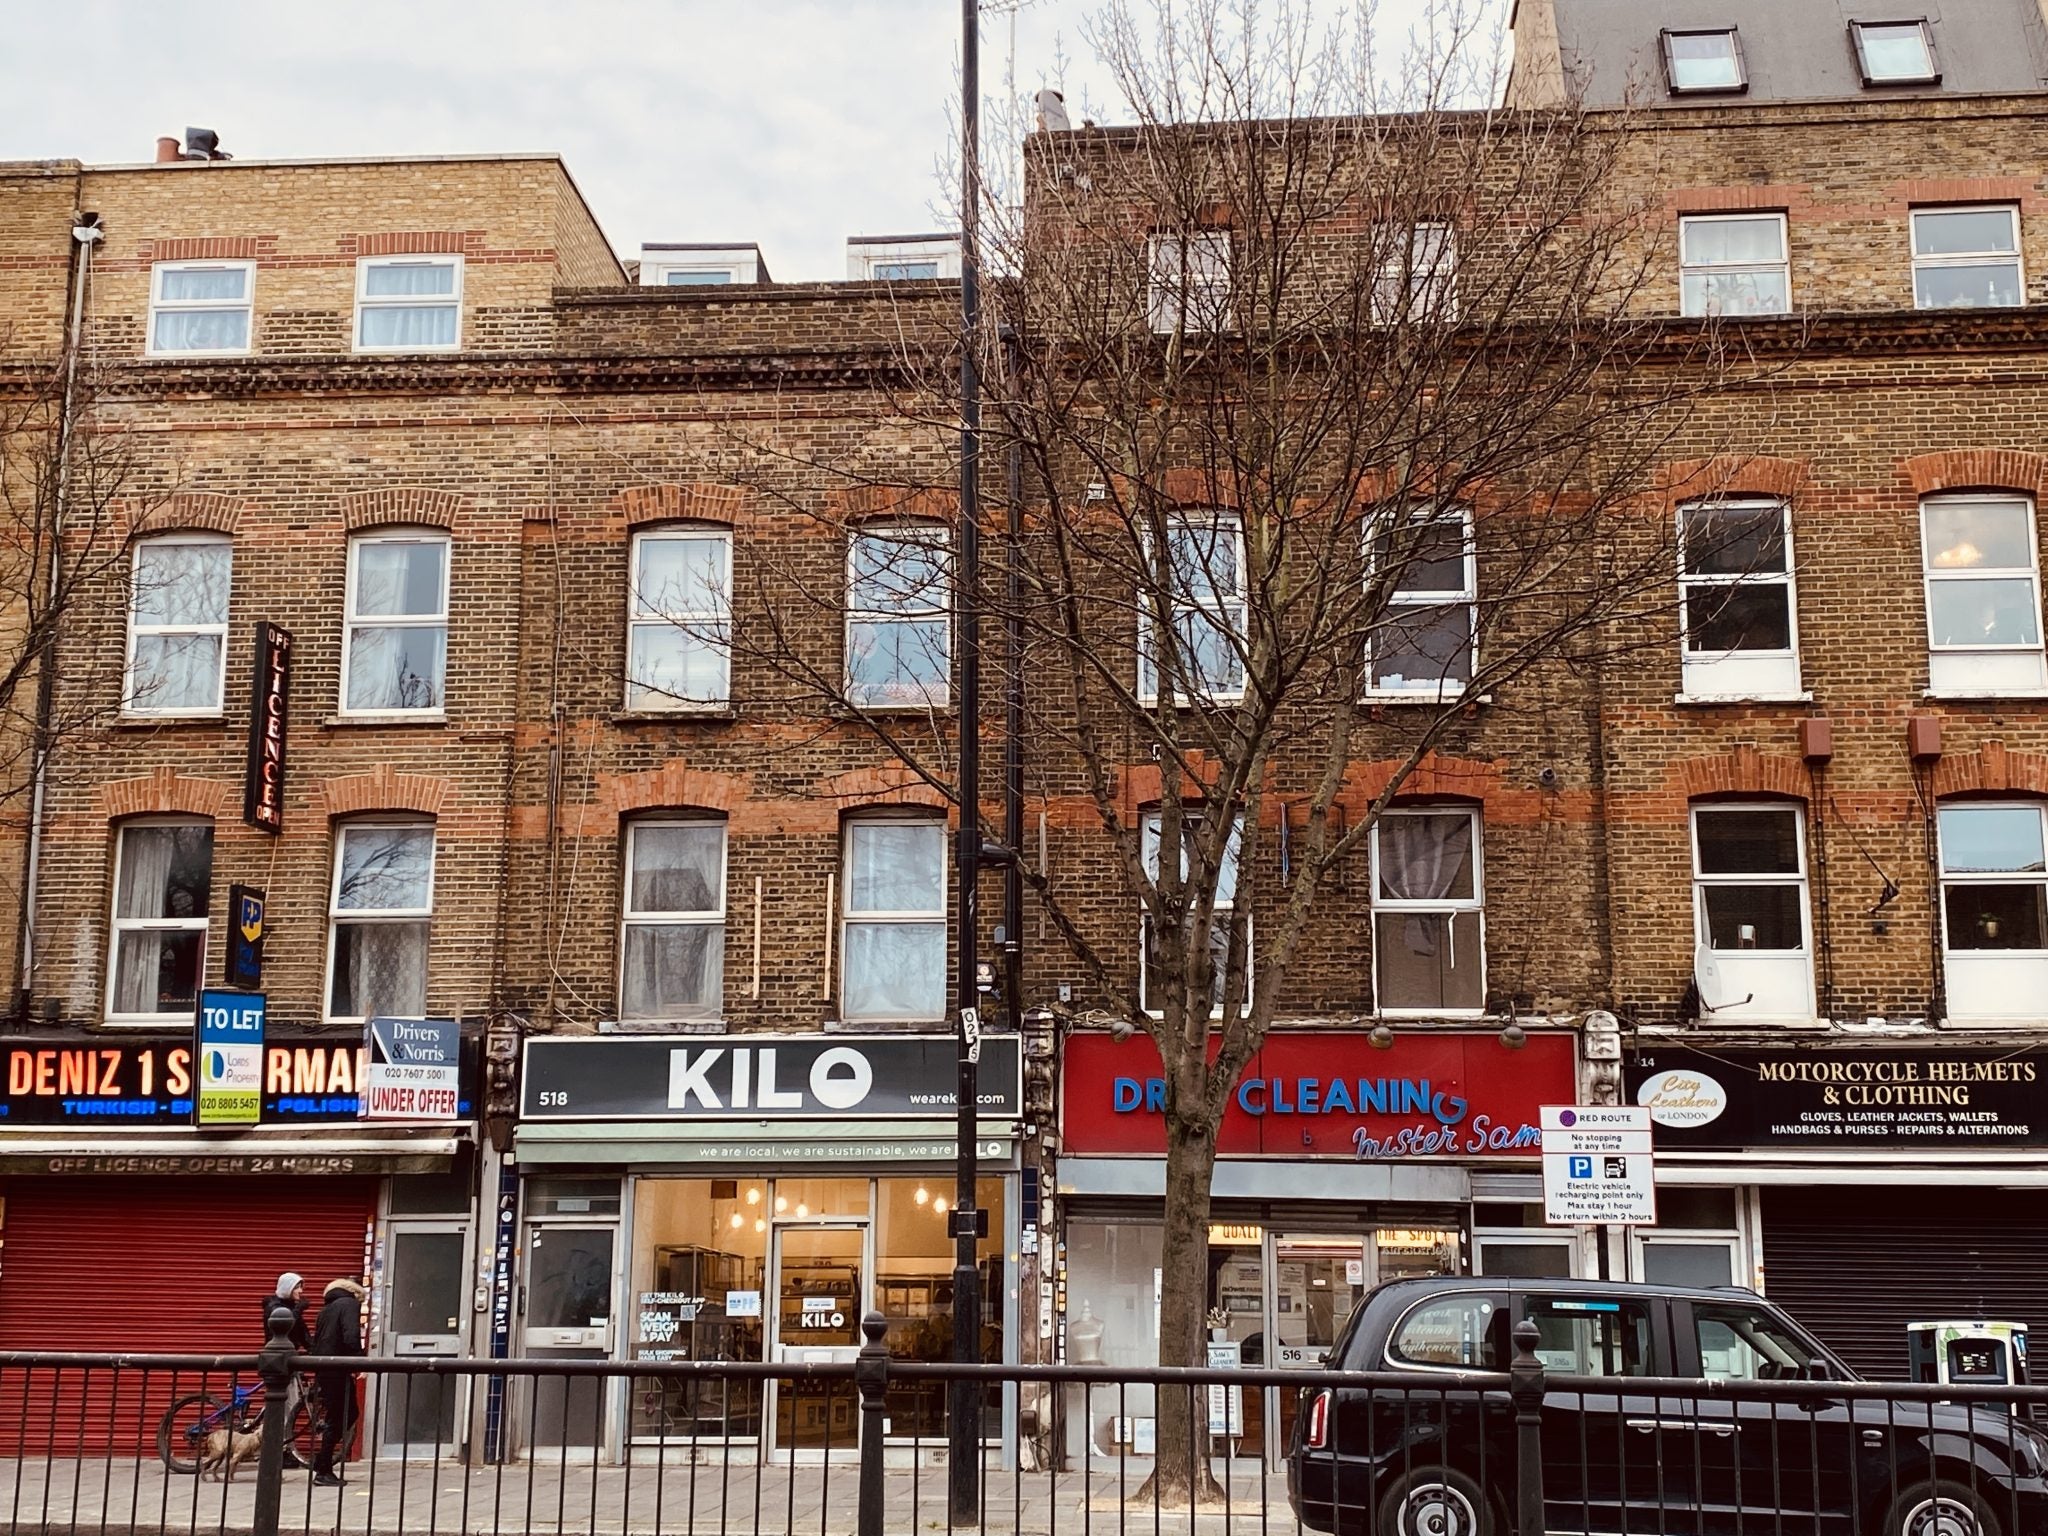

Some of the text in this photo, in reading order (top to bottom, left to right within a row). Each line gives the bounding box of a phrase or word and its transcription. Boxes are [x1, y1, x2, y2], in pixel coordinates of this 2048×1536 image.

[269, 628, 289, 650] OFF
[263, 650, 285, 806] LICENCE
[256, 804, 280, 826] OPEN
[203, 1008, 264, 1030] TO LET
[393, 1023, 440, 1041] Drivers
[9, 1050, 122, 1095] DENIZ
[138, 1050, 153, 1095] 1
[384, 1067, 446, 1080] 020 7607 5001
[666, 1046, 873, 1110] KILO
[1758, 1062, 2036, 1081] MOTORCYCLE HELMETS
[1661, 1075, 1701, 1099] City
[372, 1087, 416, 1113] UNDER
[418, 1089, 456, 1114] OFFER
[538, 1091, 568, 1106] 518
[1113, 1077, 1468, 1125] DR CLEANING
[1649, 1092, 1718, 1107] Leathers
[1823, 1086, 1970, 1105] & CLOTHING
[62, 1101, 156, 1114] TURKISH
[201, 1098, 216, 1109] 020
[219, 1098, 238, 1109] 8805
[240, 1098, 259, 1109] 5457
[278, 1098, 358, 1113] POLISH
[1667, 1111, 1708, 1120] LONDON
[1800, 1112, 1999, 1122] GLOVES, LEATHER JACKETS, WALLETS
[1466, 1115, 1542, 1153] Sam
[1771, 1125, 1832, 1135] HANDBAGS
[1833, 1125, 1842, 1135] &
[1844, 1125, 1889, 1135] PURSES
[1897, 1125, 1944, 1135] REPAIRS
[1946, 1125, 1955, 1135] &
[1957, 1125, 2030, 1135] ALTERATIONS
[1586, 1134, 1622, 1142] stopping
[699, 1147, 718, 1156] we
[721, 1147, 741, 1156] are
[745, 1145, 779, 1158] local,
[782, 1147, 801, 1156] we
[804, 1147, 824, 1156] are
[828, 1144, 905, 1157] sustainable,
[909, 1146, 927, 1155] we
[931, 1145, 952, 1155] are
[49, 1158, 354, 1173] OFF LICENCE OPEN 24 HOURS
[1574, 1158, 1589, 1177] P
[1601, 1182, 1631, 1190] vehicle
[1555, 1191, 1645, 1200] recharging point only
[1587, 1202, 1605, 1210] stay
[1549, 1212, 1561, 1220] No
[1593, 1212, 1618, 1220] within
[1629, 1212, 1652, 1220] hours
[640, 1312, 671, 1322] SCAN
[801, 1312, 845, 1328] KILO
[640, 1322, 679, 1332] WEIGH
[640, 1332, 673, 1342] & PAY
[1282, 1350, 1301, 1360] 516
